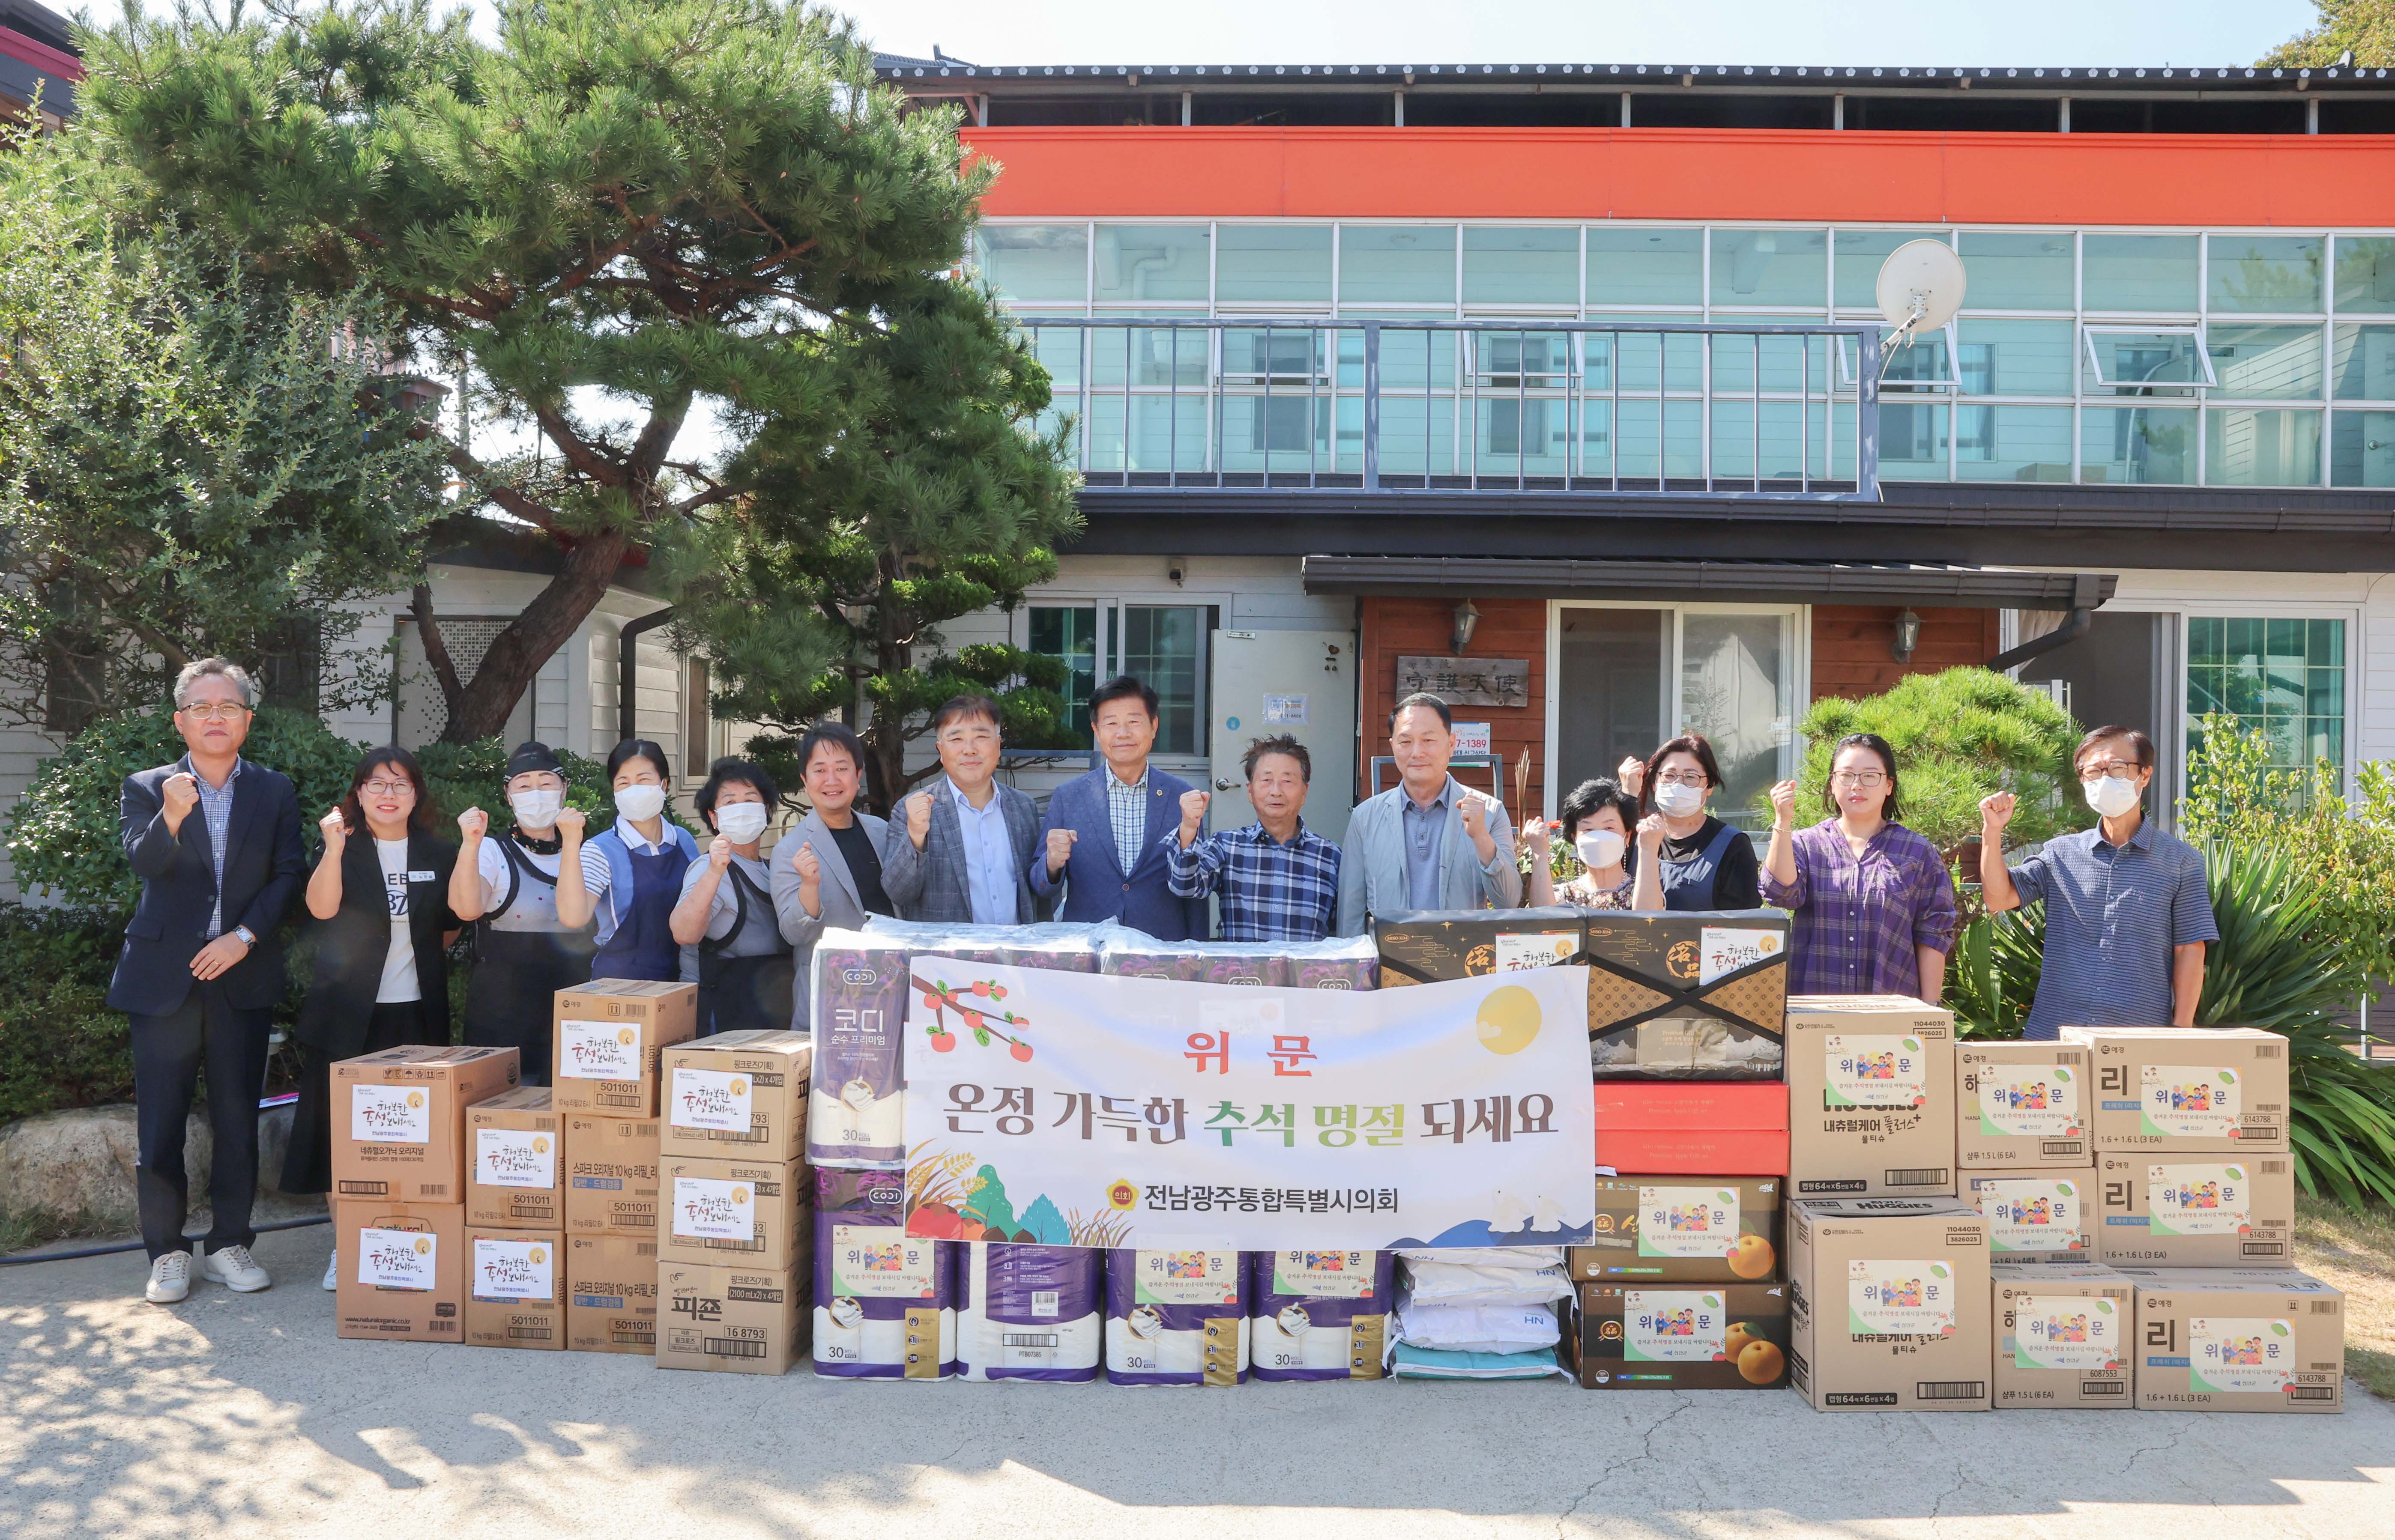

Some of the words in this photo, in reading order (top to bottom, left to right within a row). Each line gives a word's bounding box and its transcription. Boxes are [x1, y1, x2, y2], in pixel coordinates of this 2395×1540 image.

[1523, 950, 1556, 967] 행복한
[1728, 943, 1760, 961] 행복한
[1712, 951, 1737, 971] 추석
[834, 1009, 883, 1033] 코디
[587, 1036, 619, 1053] 행복한
[831, 1034, 849, 1045] 순수
[850, 1035, 886, 1046] 프리미엄
[571, 1042, 596, 1063] 추석
[1183, 1030, 1229, 1074] 위
[1266, 1035, 1318, 1077] 문
[2111, 1045, 2125, 1054] 애경
[734, 1060, 774, 1070] 핑크로즈(기획)
[1840, 1059, 1853, 1072] 위
[1898, 1059, 1911, 1072] 문
[1973, 1054, 1986, 1063] 애경
[600, 1082, 637, 1093] 5011011
[1964, 1073, 1978, 1094] 하
[2101, 1065, 2128, 1096] 리
[699, 1085, 731, 1104] 행복한
[1993, 1089, 2006, 1102] 위
[2050, 1089, 2063, 1103] 문
[2155, 1089, 2168, 1103] 위
[2213, 1091, 2227, 1105] 문
[377, 1100, 408, 1116] 행복한
[683, 1091, 707, 1113] 추석
[362, 1106, 386, 1127] 추석
[943, 1083, 1035, 1136] 온정
[1052, 1092, 1189, 1145] 가득한
[1203, 1100, 1295, 1148] 추석
[1312, 1104, 1405, 1148] 명절
[1420, 1093, 1559, 1144] 되세요
[1824, 1119, 1880, 1132] 내츄럴케어
[843, 1129, 858, 1141] 30
[1862, 1135, 1885, 1143] 물티슈
[2140, 1135, 2148, 1144] (3
[2149, 1135, 2162, 1144] EA)
[398, 1147, 424, 1156] 오리지널
[502, 1145, 534, 1161] 행복한
[1967, 1152, 1979, 1160] 샴푸
[1997, 1151, 2004, 1160] (6
[2005, 1151, 2016, 1160] EA)
[487, 1151, 512, 1171] 추석
[573, 1162, 592, 1175] 스파크
[593, 1163, 614, 1178] 오리지널
[615, 1165, 623, 1177] 10
[624, 1166, 633, 1179] kg
[730, 1168, 771, 1180] 핑크로즈(기획)
[514, 1195, 550, 1205] 5011011
[1115, 1191, 1131, 1202] 의회
[1144, 1184, 1399, 1214] 전남광주통합특별시의회
[2105, 1180, 2132, 1212] 리
[2163, 1189, 2176, 1203] 위
[2222, 1187, 2235, 1201] 문
[614, 1203, 652, 1212] 5011011
[700, 1194, 733, 1212] 행복한
[685, 1200, 709, 1222] 추석
[1653, 1211, 1666, 1225] 위
[1712, 1211, 1725, 1225] 문
[1996, 1205, 2008, 1218] 위
[2053, 1204, 2066, 1218] 문
[2249, 1231, 2276, 1239] 6143788
[385, 1245, 416, 1261] 행복한
[847, 1249, 860, 1265] 위
[906, 1250, 920, 1265] 문
[1289, 1251, 1303, 1263] 위
[1348, 1252, 1361, 1265] 문
[370, 1250, 393, 1271] 추석
[499, 1256, 530, 1272] 행복한
[1150, 1258, 1163, 1272] 위
[1209, 1258, 1223, 1272] 문
[484, 1262, 507, 1283] 추석
[730, 1274, 772, 1286] 핑크로즈(기획)
[729, 1289, 745, 1298] (2100
[767, 1291, 782, 1301] 4개입
[1864, 1286, 1878, 1300] 위
[1925, 1286, 1940, 1300] 문
[671, 1296, 722, 1322] 피죤
[2158, 1299, 2172, 1307] 애경
[511, 1316, 548, 1326] 5011011
[615, 1320, 652, 1330] 5011011
[1639, 1315, 1652, 1329] 위
[1697, 1316, 1711, 1329] 문
[2030, 1320, 2044, 1335] 위
[2090, 1321, 2104, 1336] 문
[727, 1327, 739, 1337] 16
[741, 1328, 765, 1339] 8793
[2147, 1319, 2175, 1352] 리
[828, 1347, 843, 1358] 30
[1892, 1346, 1917, 1355] 물티슈
[2204, 1344, 2218, 1358] 위
[2266, 1343, 2280, 1358] 문
[1127, 1357, 1142, 1368] 30
[1275, 1354, 1289, 1365] 30
[2090, 1370, 2117, 1378] 6087553
[2298, 1374, 2326, 1382] 6143788
